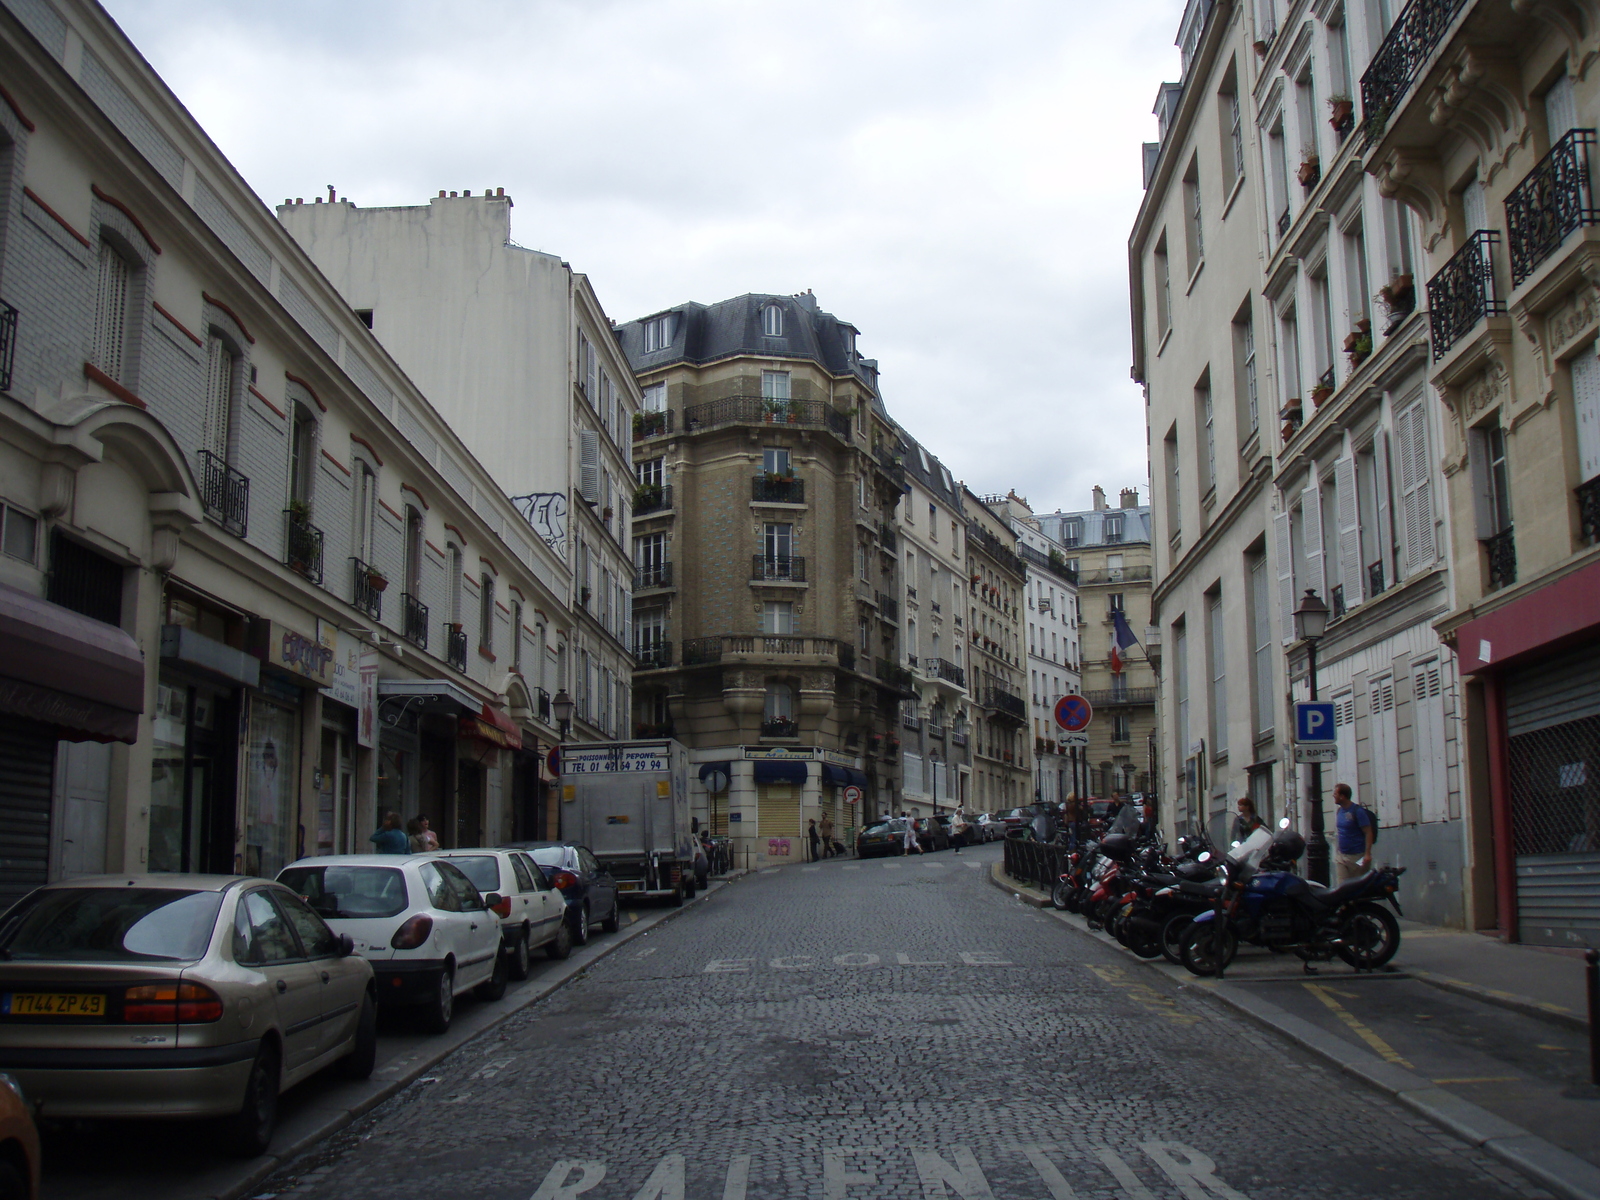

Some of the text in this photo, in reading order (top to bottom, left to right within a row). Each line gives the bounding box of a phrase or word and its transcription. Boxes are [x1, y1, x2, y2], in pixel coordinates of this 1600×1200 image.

[1307, 710, 1325, 735] P
[625, 751, 655, 760] PEPONE
[1297, 750, 1303, 758] 2
[572, 762, 586, 773] TEL
[589, 762, 600, 772] 01
[605, 761, 616, 772] 42
[635, 760, 646, 771] 29
[650, 759, 661, 770] 94
[704, 951, 1013, 973] ECOLE
[16, 995, 101, 1013] 7744 ZP 49
